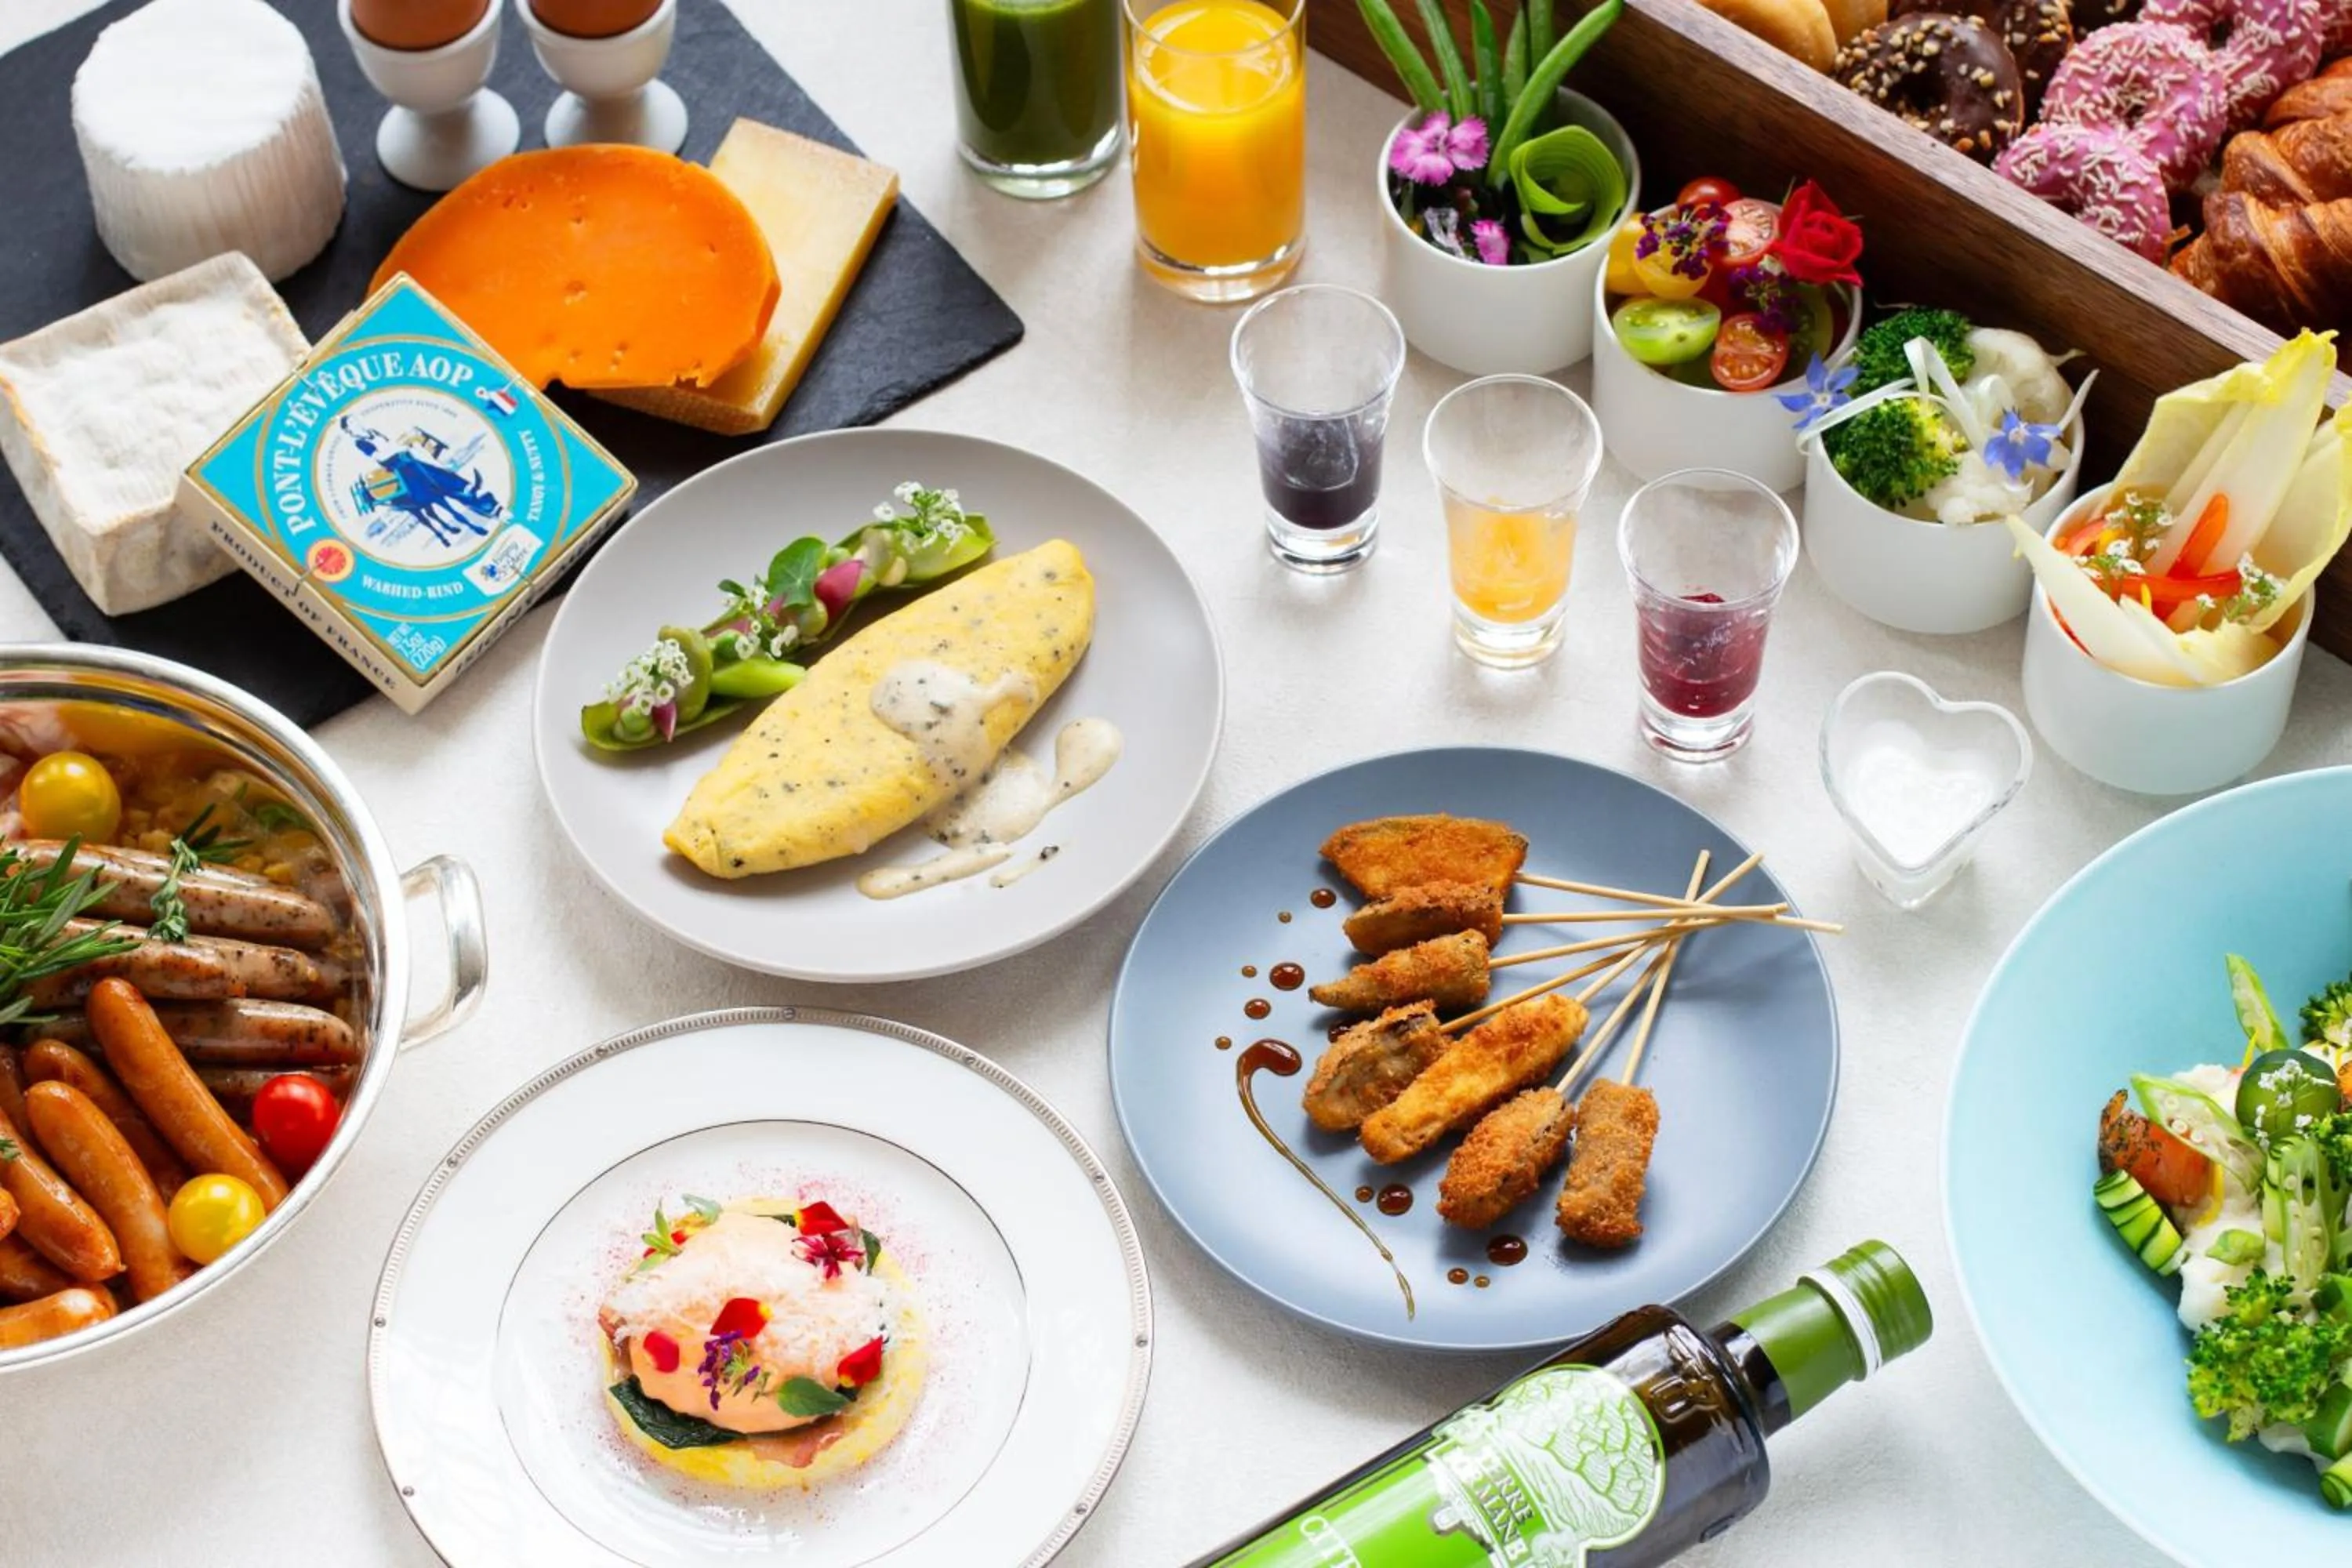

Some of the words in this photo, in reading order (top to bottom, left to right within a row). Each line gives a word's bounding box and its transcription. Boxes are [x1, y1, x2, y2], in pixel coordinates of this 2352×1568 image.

[408, 352, 474, 387] AOP
[210, 521, 296, 598] PRODUCT
[297, 601, 322, 622] OF
[325, 625, 396, 689] FRANCE
